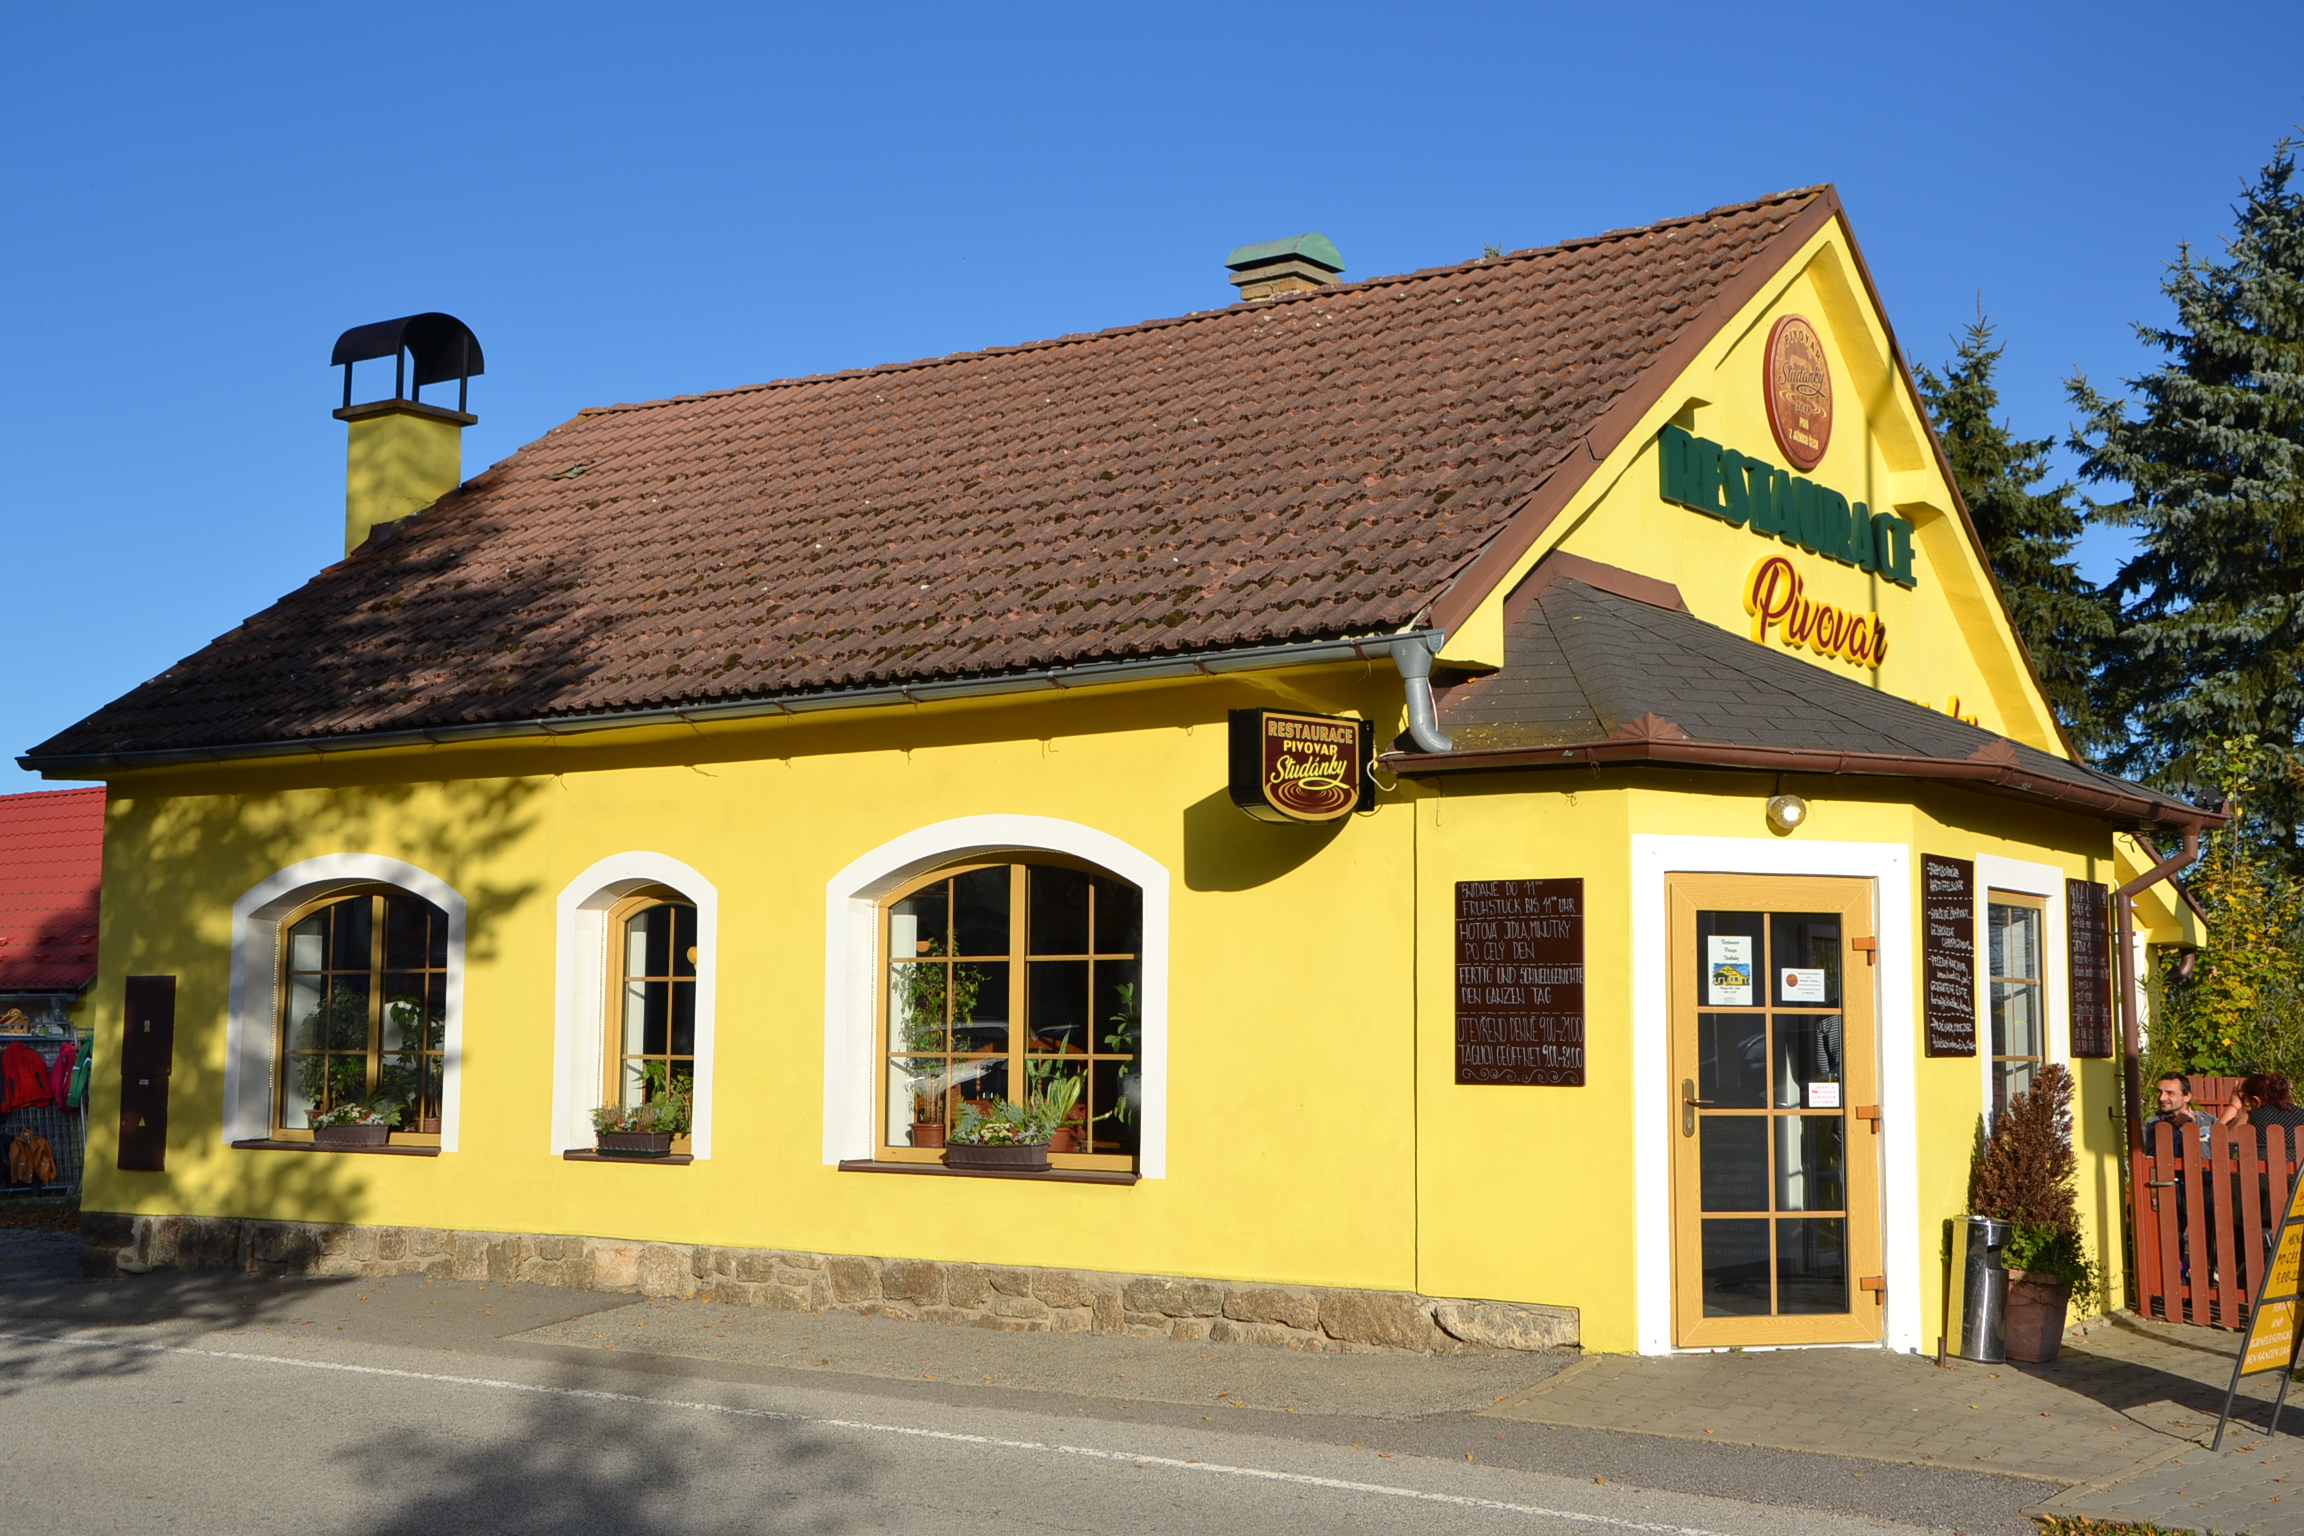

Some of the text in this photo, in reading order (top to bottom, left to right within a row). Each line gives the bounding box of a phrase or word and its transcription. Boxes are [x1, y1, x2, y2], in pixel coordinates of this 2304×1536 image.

[1784, 330, 1821, 360] PIVOVAR
[1779, 362, 1825, 388] Studánky
[1660, 423, 1918, 590] RESTAURACE
[1748, 556, 1888, 667] Pivovar
[1267, 720, 1354, 745] RESTAURACE
[1283, 739, 1338, 756] PIVOVAR
[1270, 753, 1348, 784] Studánky
[1505, 882, 1518, 897] DO
[1525, 897, 1540, 914] BIS
[1558, 898, 1576, 914] UHR
[1465, 941, 1536, 961] PO CELÝ DEN
[1459, 966, 1494, 984] FERTIG
[1497, 966, 1517, 984] UND
[1461, 987, 1552, 1005] DEN GANZEN TAG
[1510, 1015, 1540, 1042] DENNĚ
[1457, 1043, 1495, 1066] TÄGLICH
[1496, 1044, 1541, 1067] GEÖFFNET
